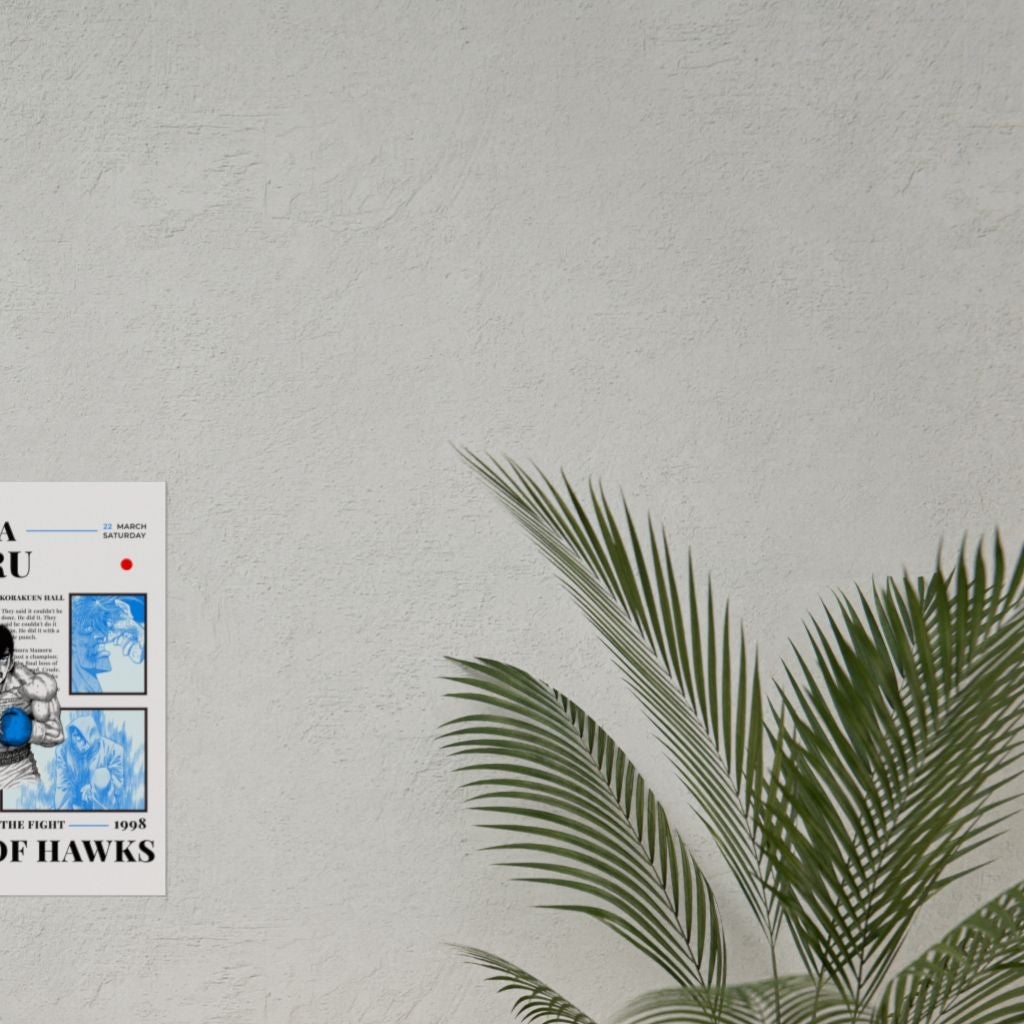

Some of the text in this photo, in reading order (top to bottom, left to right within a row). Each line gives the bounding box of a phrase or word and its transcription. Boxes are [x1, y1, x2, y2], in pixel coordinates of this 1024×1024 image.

[103, 523, 147, 531] 22 MARCH
[0, 820, 66, 830] THE FIGHT
[114, 817, 147, 831] 1998
[37, 839, 156, 863] HAWKS
